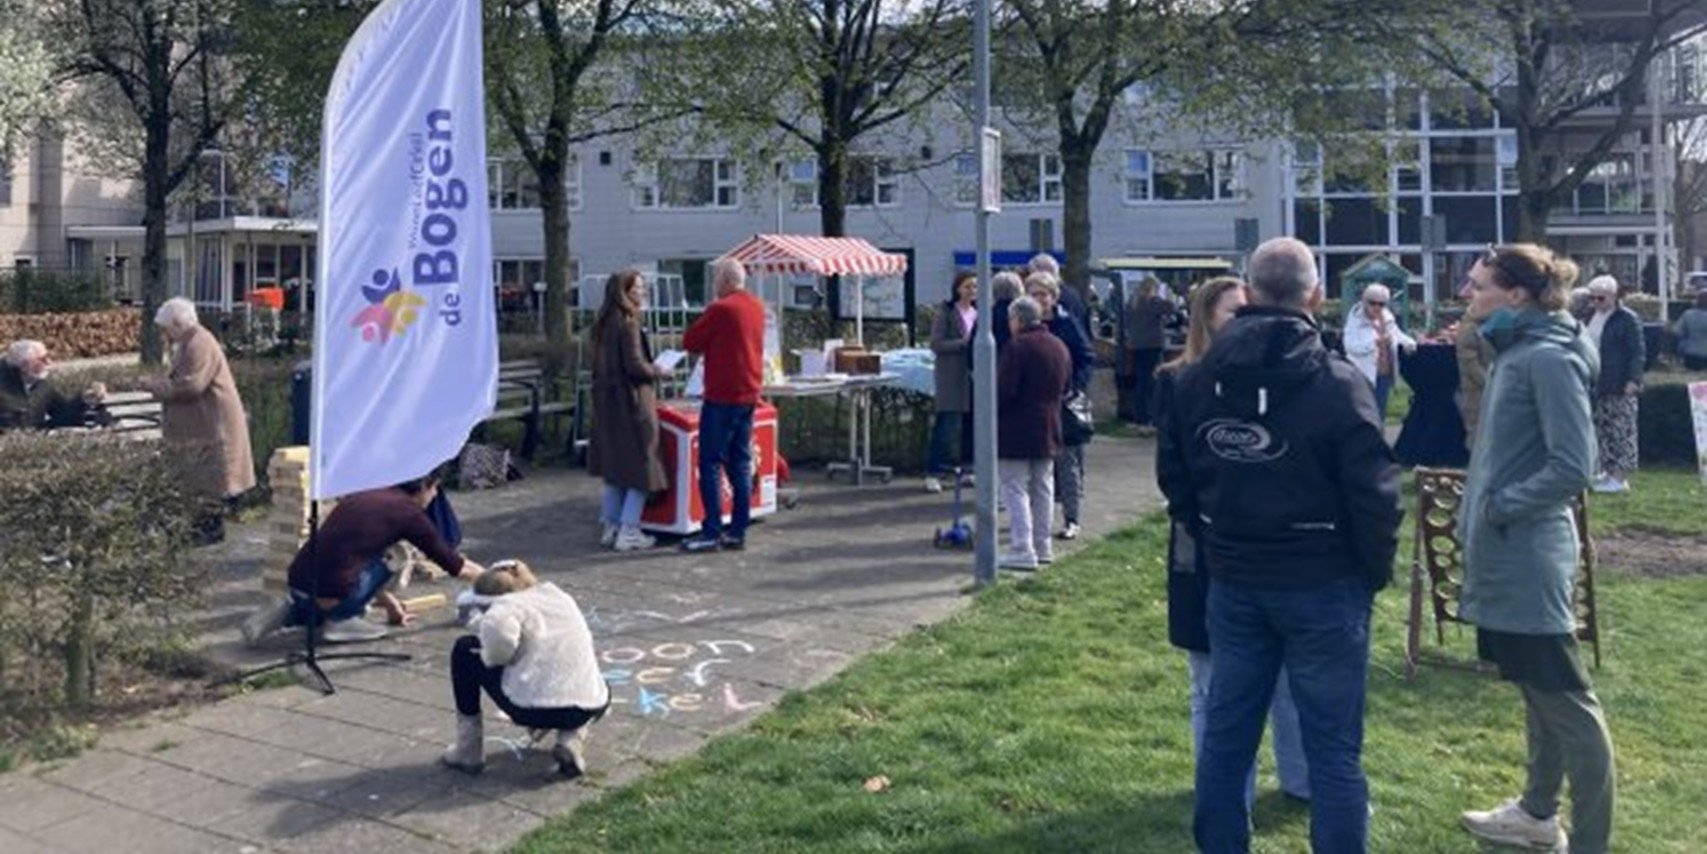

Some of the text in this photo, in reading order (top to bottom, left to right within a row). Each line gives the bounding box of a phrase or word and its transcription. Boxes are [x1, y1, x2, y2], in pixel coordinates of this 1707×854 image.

[413, 109, 468, 326] de Bogen
[601, 639, 756, 663] oon
